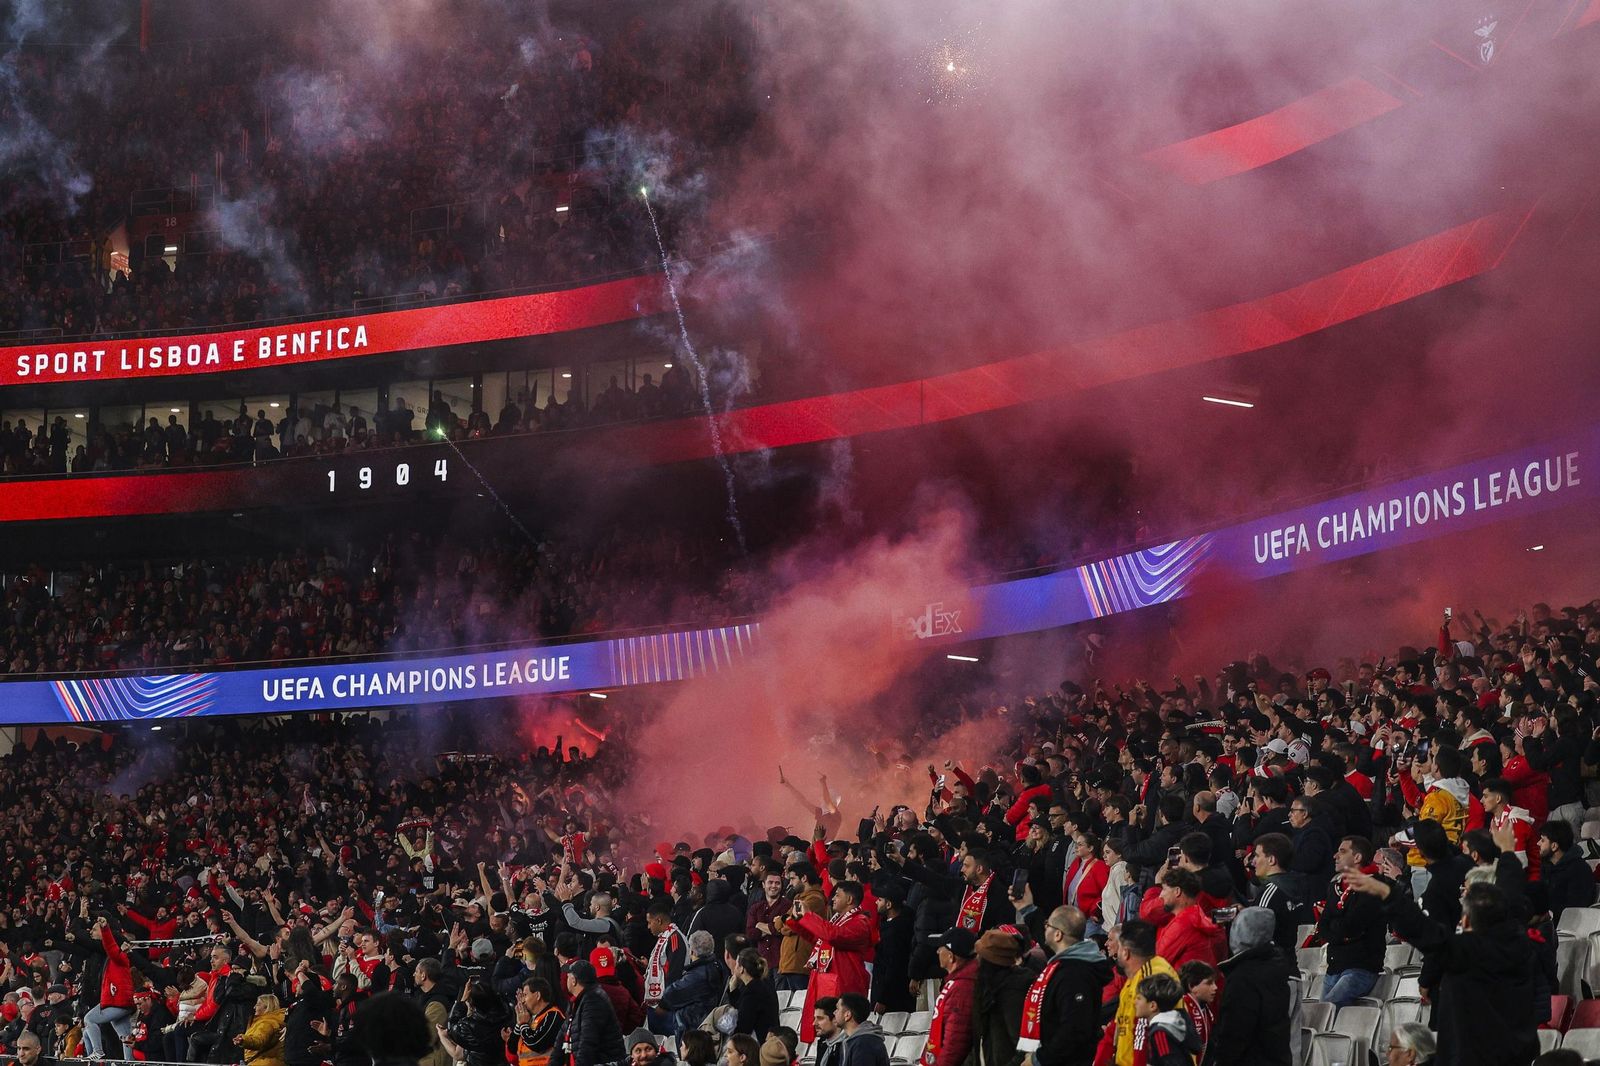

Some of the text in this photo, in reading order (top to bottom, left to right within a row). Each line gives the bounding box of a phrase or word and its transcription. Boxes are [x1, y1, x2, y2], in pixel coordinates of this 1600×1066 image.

[165, 217, 177, 227] 18
[17, 325, 368, 376] SPORT LISBOA E BENFICA
[1254, 451, 1581, 564] UEFA CHAMPIONS LEAGUE
[262, 656, 570, 702] UEFA CHAMPIONS LEAGUE
[1031, 987, 1041, 1004] SL
